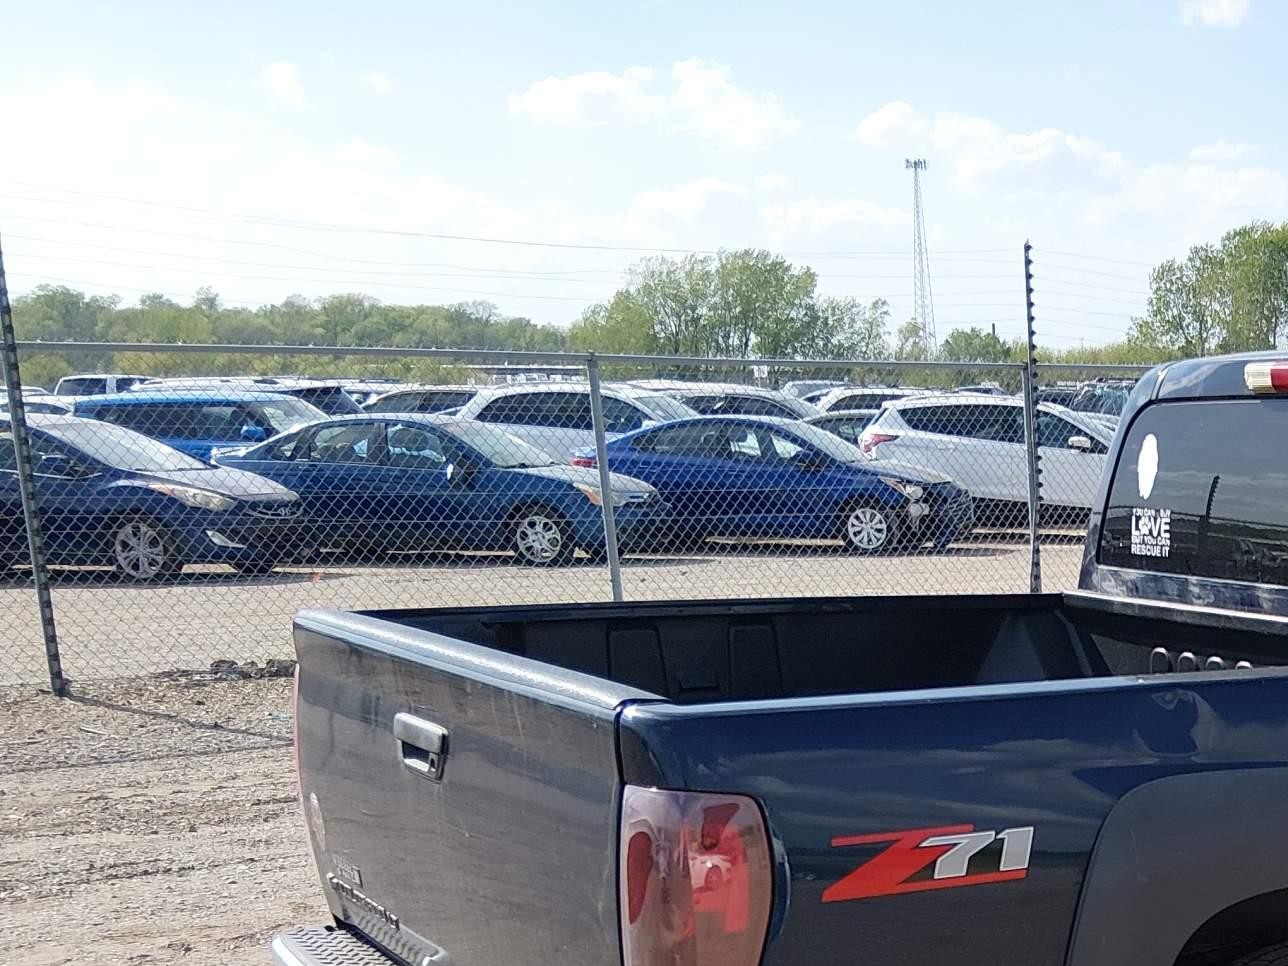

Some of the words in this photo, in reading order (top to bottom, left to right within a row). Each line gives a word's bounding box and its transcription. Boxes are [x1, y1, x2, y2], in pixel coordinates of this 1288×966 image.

[1131, 535, 1143, 544] BUT
[1144, 536, 1157, 545] YOU
[1157, 537, 1170, 546] CAN
[1131, 543, 1161, 557] RESCUE
[1162, 545, 1170, 558] IT
[821, 823, 1034, 903] Z71
